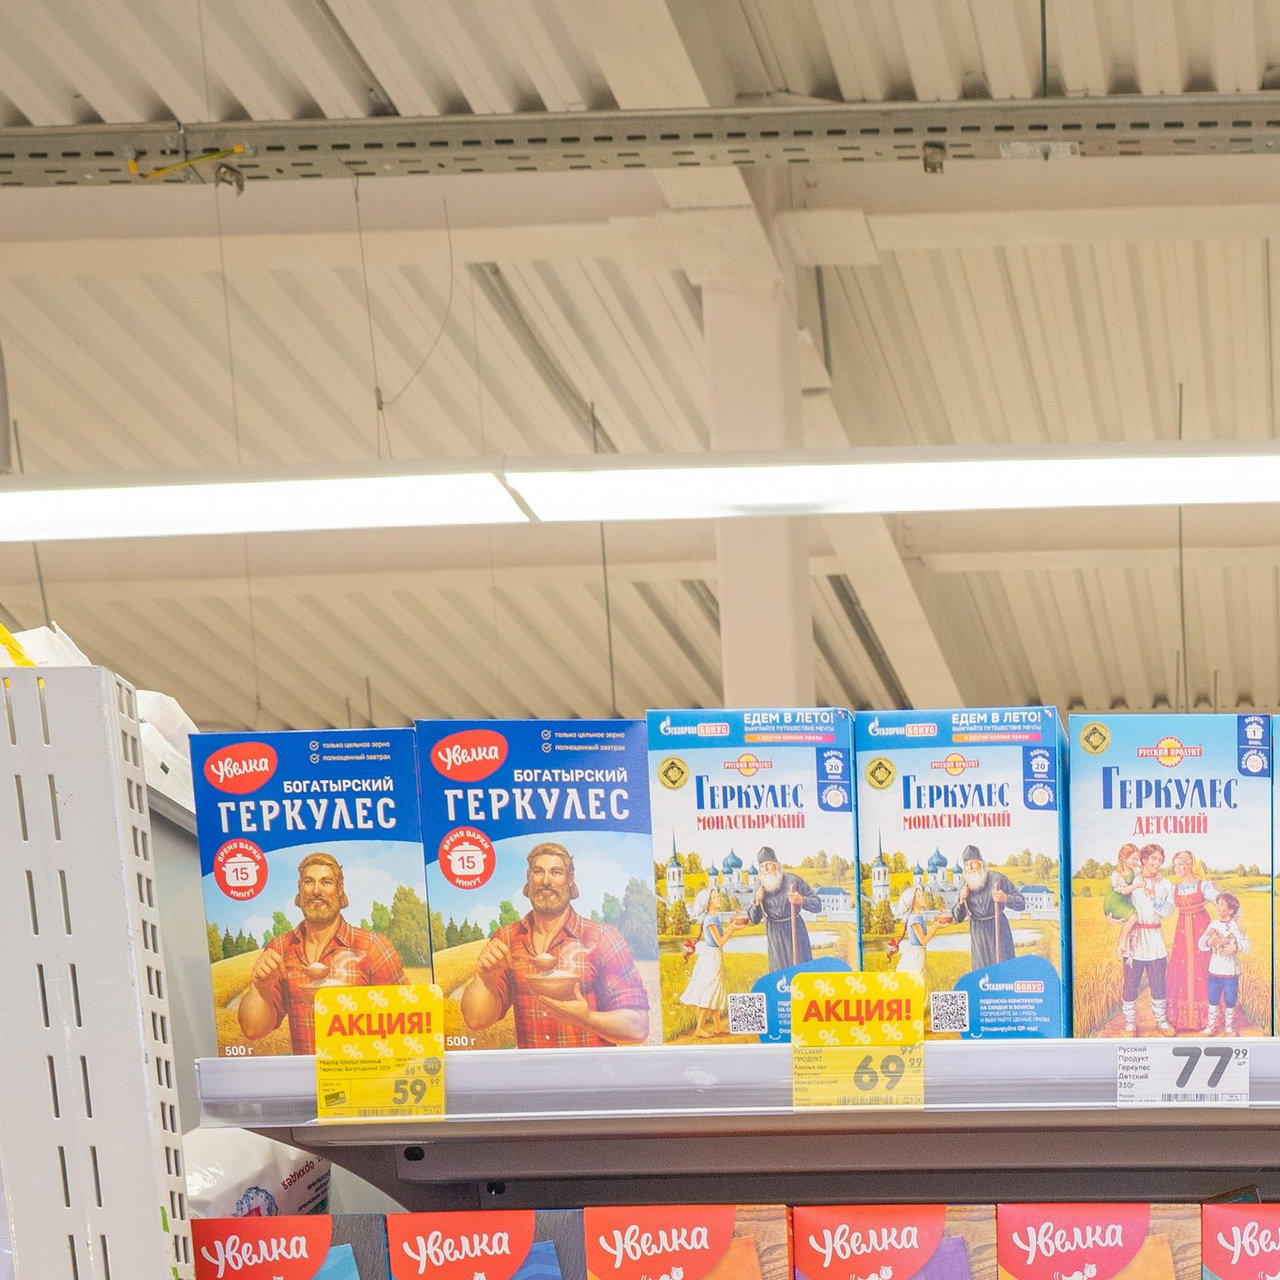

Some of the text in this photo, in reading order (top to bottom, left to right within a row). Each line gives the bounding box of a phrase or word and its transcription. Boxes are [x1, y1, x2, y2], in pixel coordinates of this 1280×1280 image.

[744, 712, 834, 724] ЕДЕМ В ЛЕТО!
[210, 754, 271, 783] Увелка
[514, 769, 628, 783] БОГАТЫРСКИЙ
[283, 778, 394, 793] БОГАТЫРСКИЙ
[217, 797, 396, 834] ГЕРКУЛЕС
[444, 788, 630, 821] ГЕРКУЛЕС
[696, 813, 806, 831] МОНАСТЫРСКИЙ
[1133, 812, 1208, 836] ДЕТСКИЙ
[327, 1011, 433, 1039] АКЦИЯ!
[803, 999, 912, 1025] АКЦИЯ!
[853, 1055, 905, 1092] 69
[1172, 1047, 1234, 1088] 77
[392, 1079, 428, 1105] 59
[201, 1232, 309, 1278] Увелка
